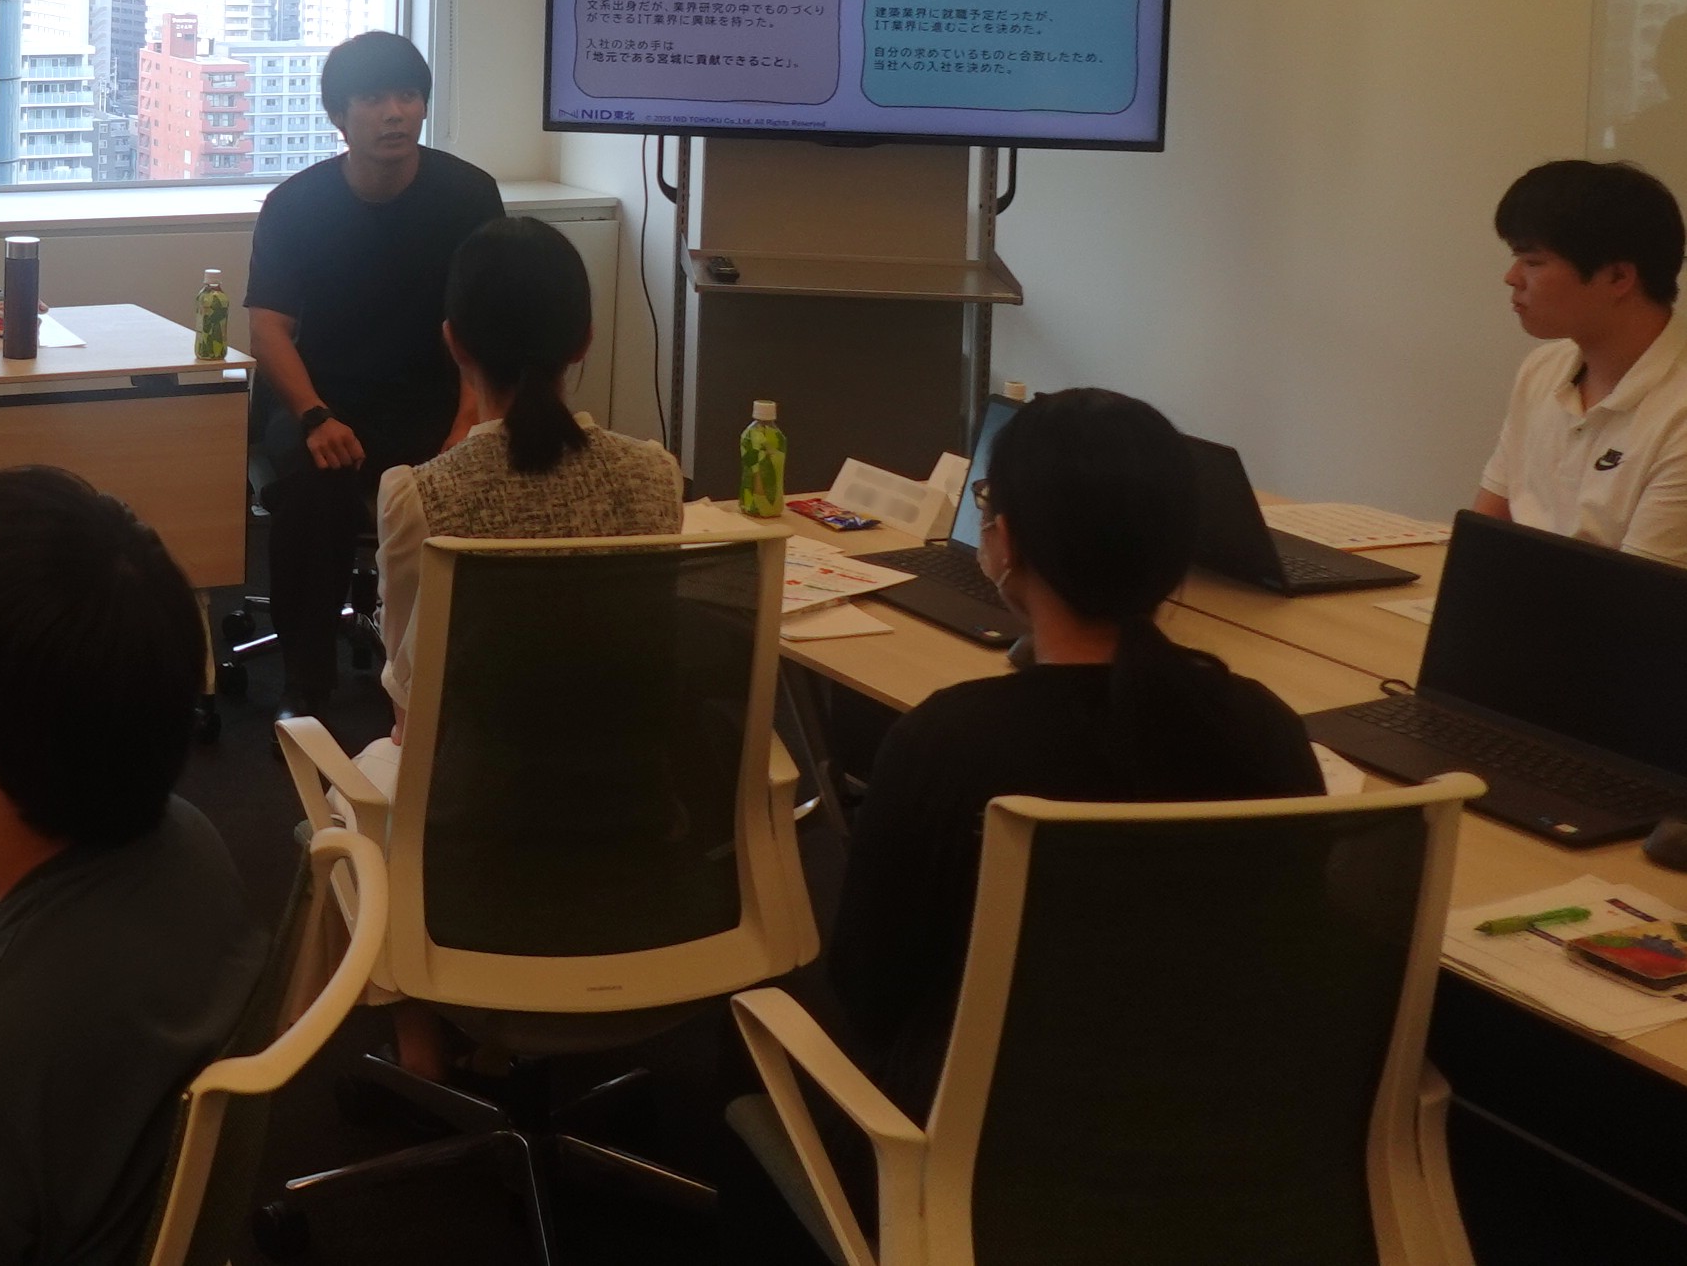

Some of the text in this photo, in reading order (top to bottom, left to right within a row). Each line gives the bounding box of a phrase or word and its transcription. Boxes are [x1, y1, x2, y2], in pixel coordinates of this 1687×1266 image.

[586, 37, 674, 51] 入社の決め手は
[873, 60, 1013, 75] 当社への入社を決めた。
